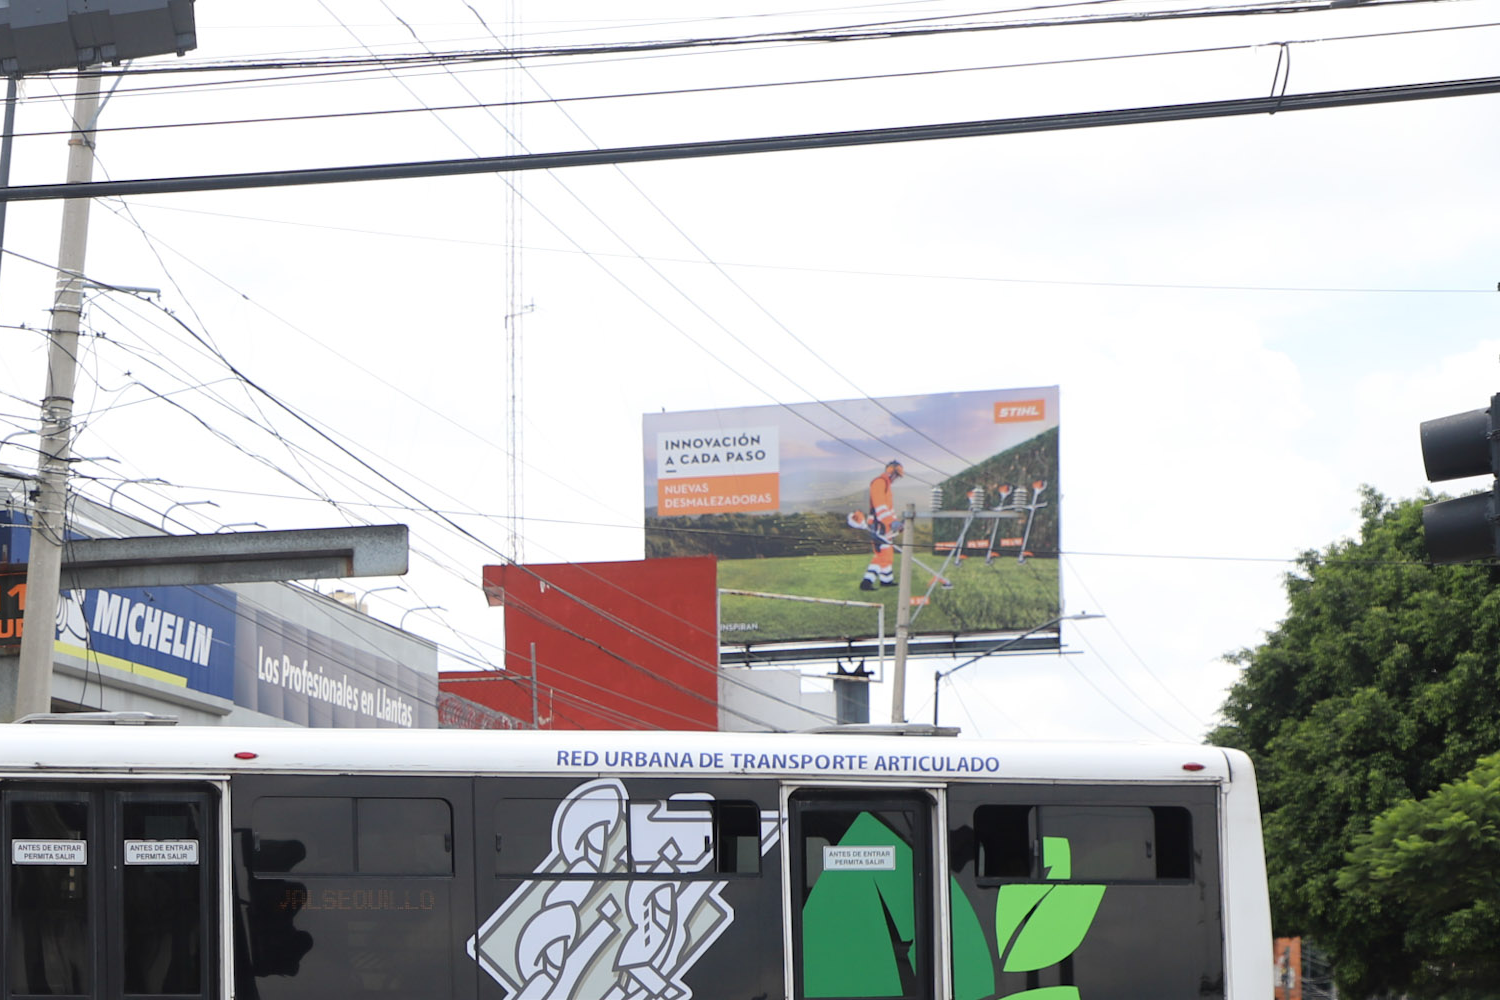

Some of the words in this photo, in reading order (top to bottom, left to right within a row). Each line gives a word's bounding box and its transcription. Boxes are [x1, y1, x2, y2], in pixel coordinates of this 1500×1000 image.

[999, 405, 1040, 418] STIHL
[665, 433, 760, 450] INNOVACIÓN
[665, 456, 674, 465] A
[680, 453, 720, 465] CADA
[726, 450, 766, 462] PASO
[664, 483, 709, 494] NUEVAS
[665, 493, 772, 508] DESMALEZADORAS
[93, 589, 214, 667] MICHELIN
[258, 645, 280, 685] Los
[282, 654, 359, 714] Profesionales
[361, 695, 374, 718] en
[376, 687, 413, 728] Llantas
[556, 750, 599, 767] RED
[604, 751, 694, 768] URBANA
[699, 752, 724, 768] DE
[730, 753, 868, 770] TRANSPORTE
[874, 755, 1000, 773] ARTICULADO
